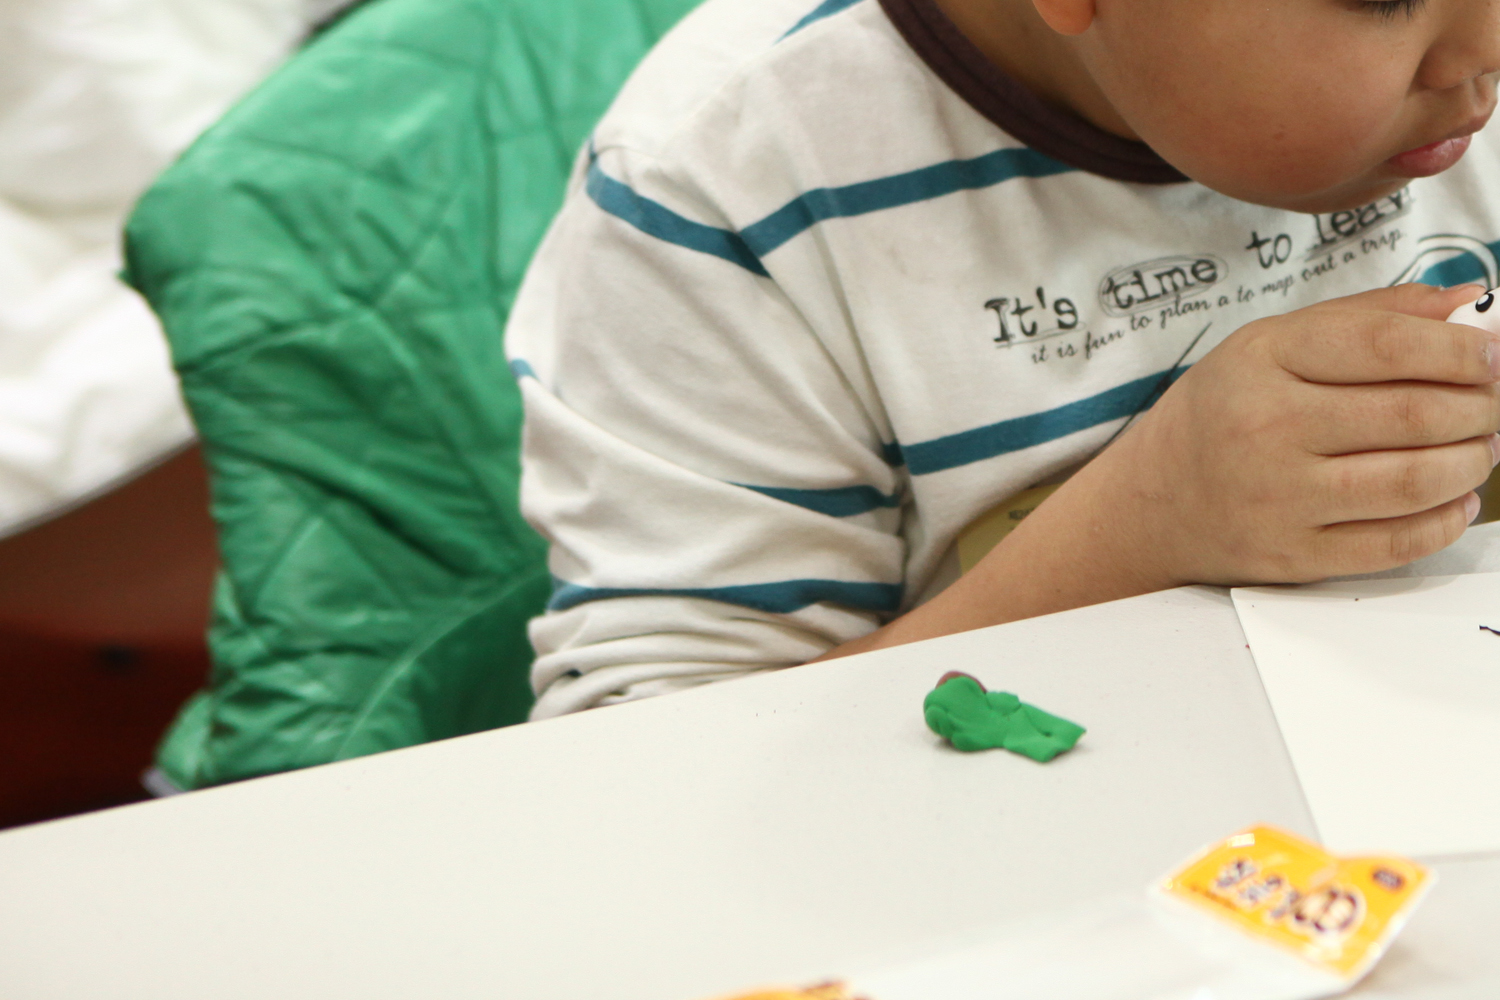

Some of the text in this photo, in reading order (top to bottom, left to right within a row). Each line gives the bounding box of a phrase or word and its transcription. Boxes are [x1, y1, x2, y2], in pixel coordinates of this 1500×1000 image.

[984, 286, 1078, 342] It's
[1102, 258, 1218, 309] time
[1246, 231, 1292, 269] to
[1031, 344, 1048, 364] it
[1057, 341, 1077, 358] is
[1085, 331, 1124, 360] fun
[1129, 313, 1151, 331] to
[1159, 295, 1211, 330] plan
[1218, 295, 1230, 308] a
[1301, 253, 1338, 282] out
[1343, 251, 1356, 264] a
